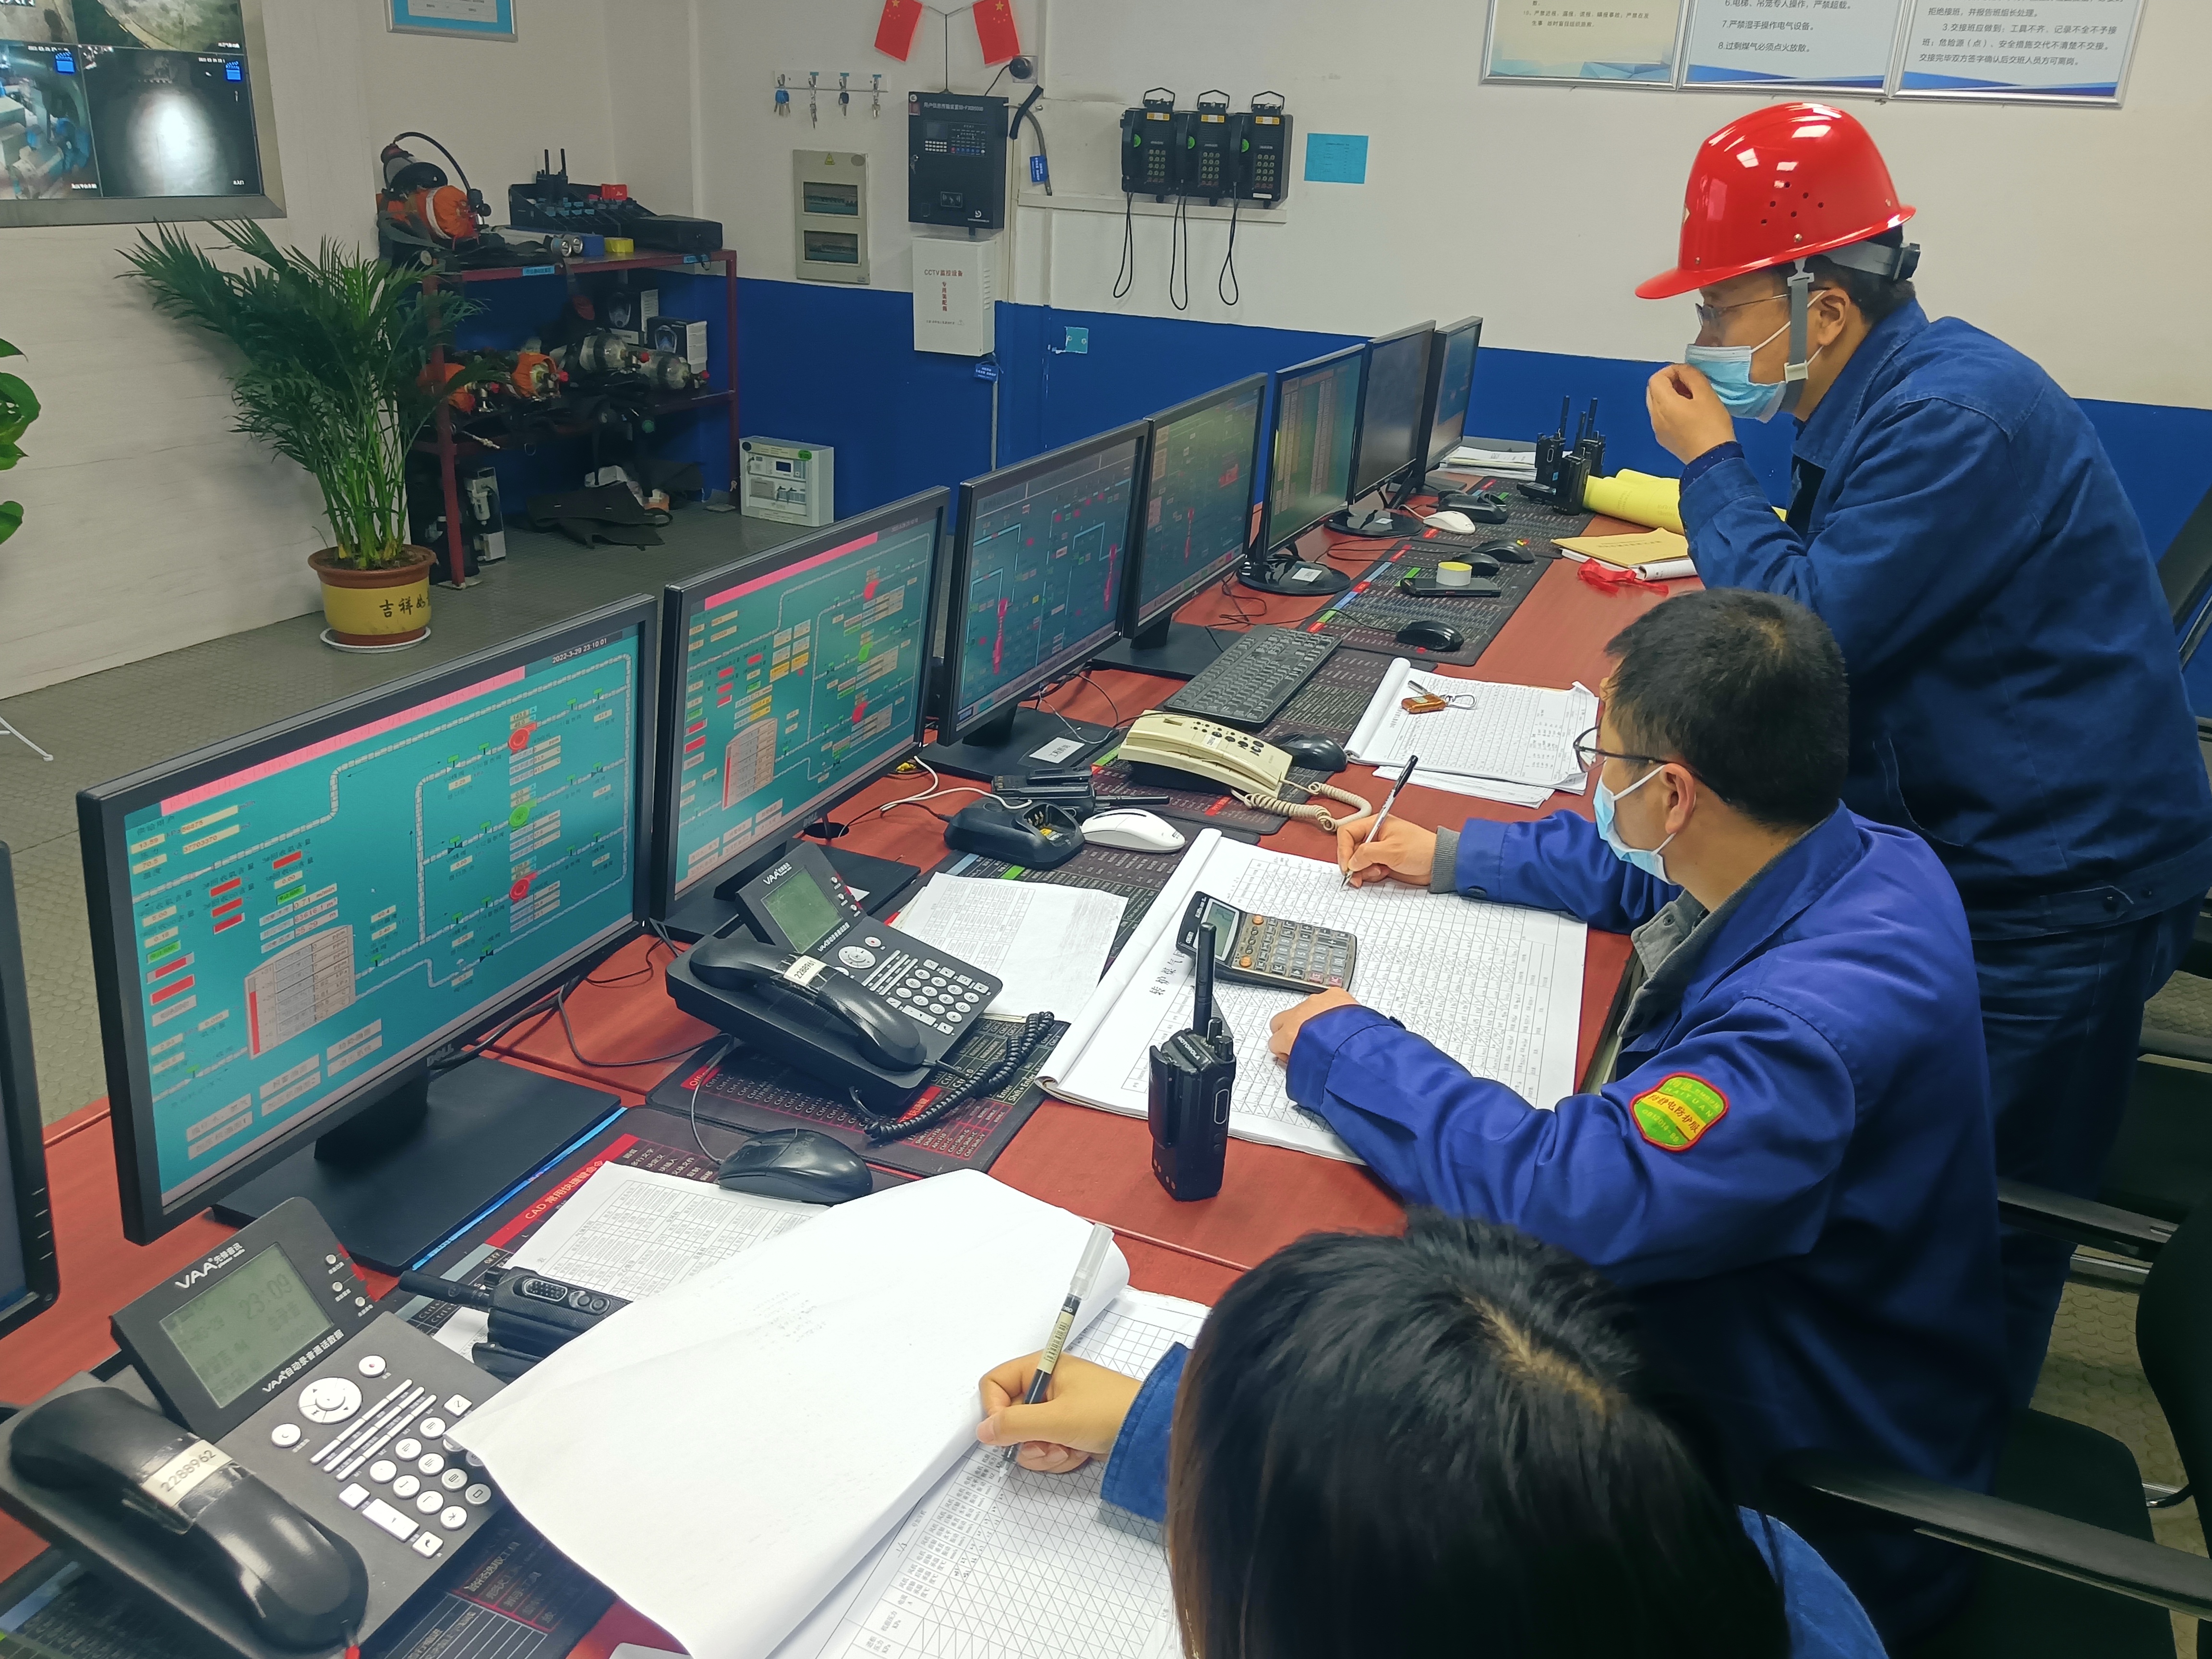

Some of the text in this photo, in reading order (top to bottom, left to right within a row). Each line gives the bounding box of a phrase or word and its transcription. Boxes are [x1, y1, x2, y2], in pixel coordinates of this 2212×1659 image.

[793, 959, 817, 979] 2288961
[1177, 1035, 1201, 1060] MOTOROLA
[715, 1075, 734, 1091] Ctrl+C
[726, 1078, 745, 1094] Ctrl+X
[737, 1080, 755, 1097] Ctrl+V
[997, 1084, 1013, 1099] Enter
[1648, 1094, 1700, 1134] 防静电防护服
[525, 1203, 547, 1220] CAD
[175, 1260, 217, 1289] VAA
[262, 1329, 345, 1393] VAA 自动录音通话数据
[160, 1450, 216, 1492] 2288962
